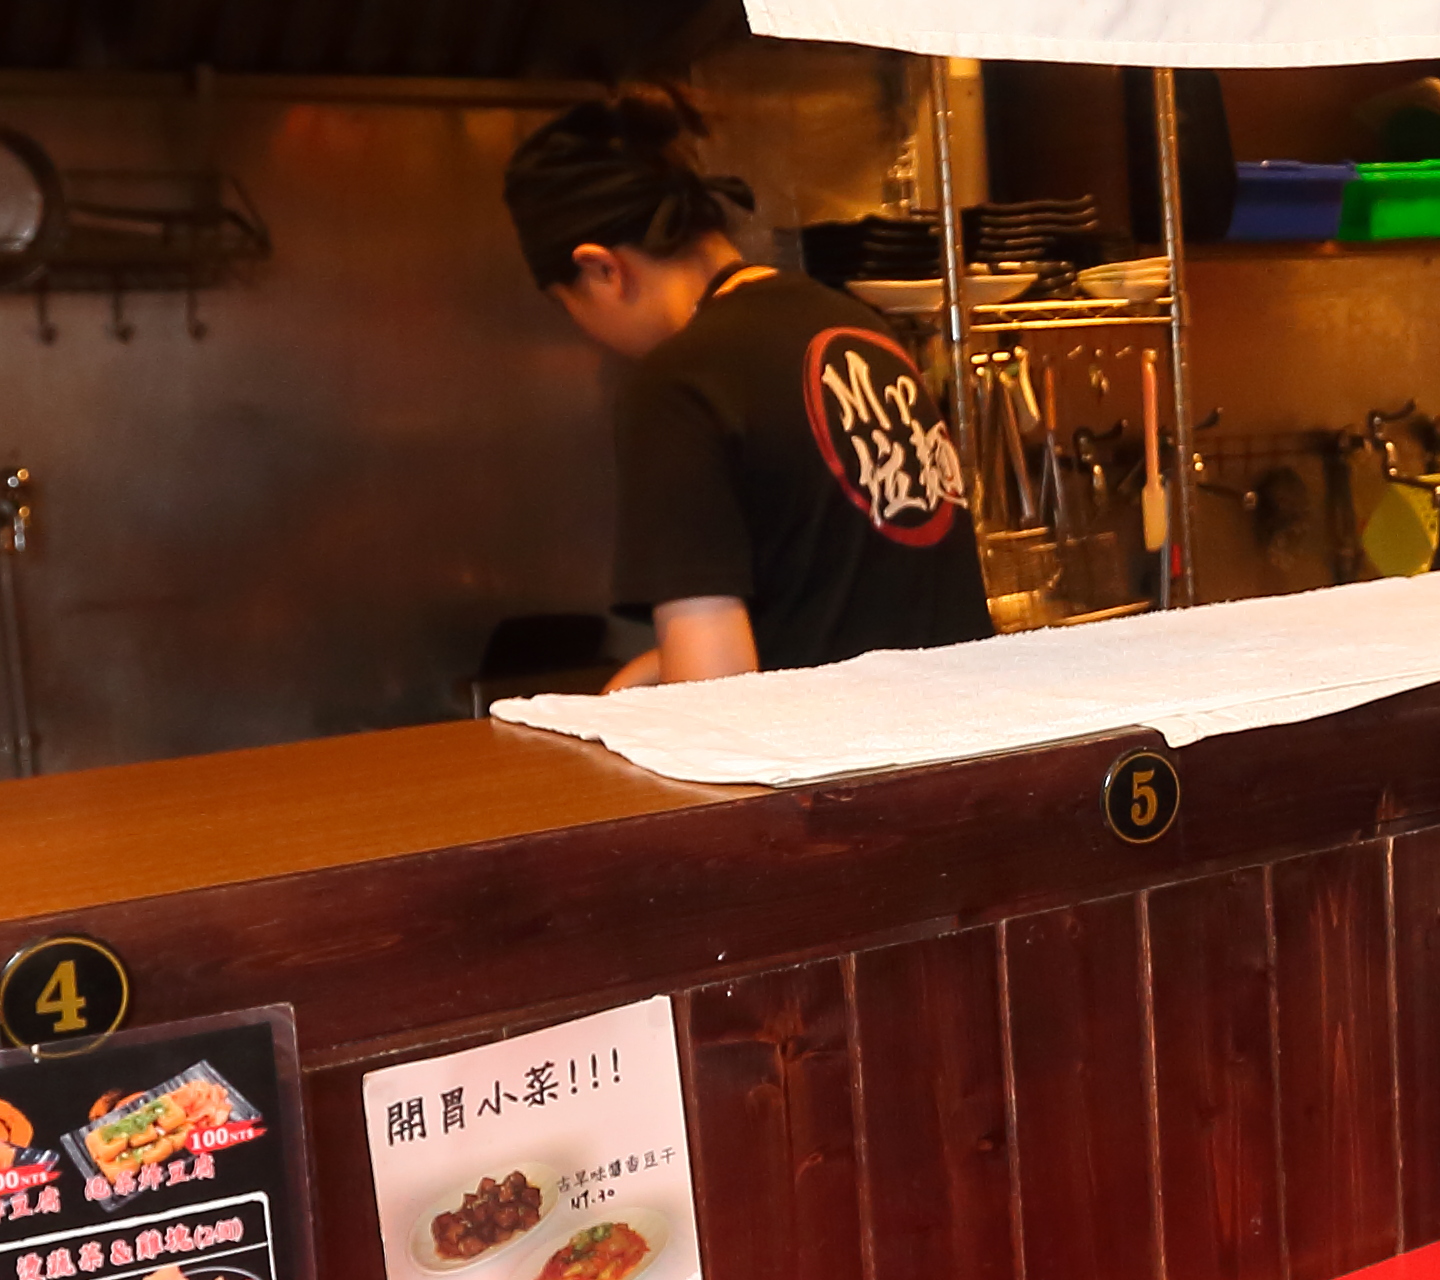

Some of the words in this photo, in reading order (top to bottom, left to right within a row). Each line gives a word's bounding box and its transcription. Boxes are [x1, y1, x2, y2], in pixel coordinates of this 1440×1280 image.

[822, 348, 919, 432] Mr
[846, 418, 967, 530] 拉麵
[1131, 769, 1156, 827] 5
[35, 959, 87, 1034] 4
[386, 1047, 623, 1147] 開胃小菜!!!
